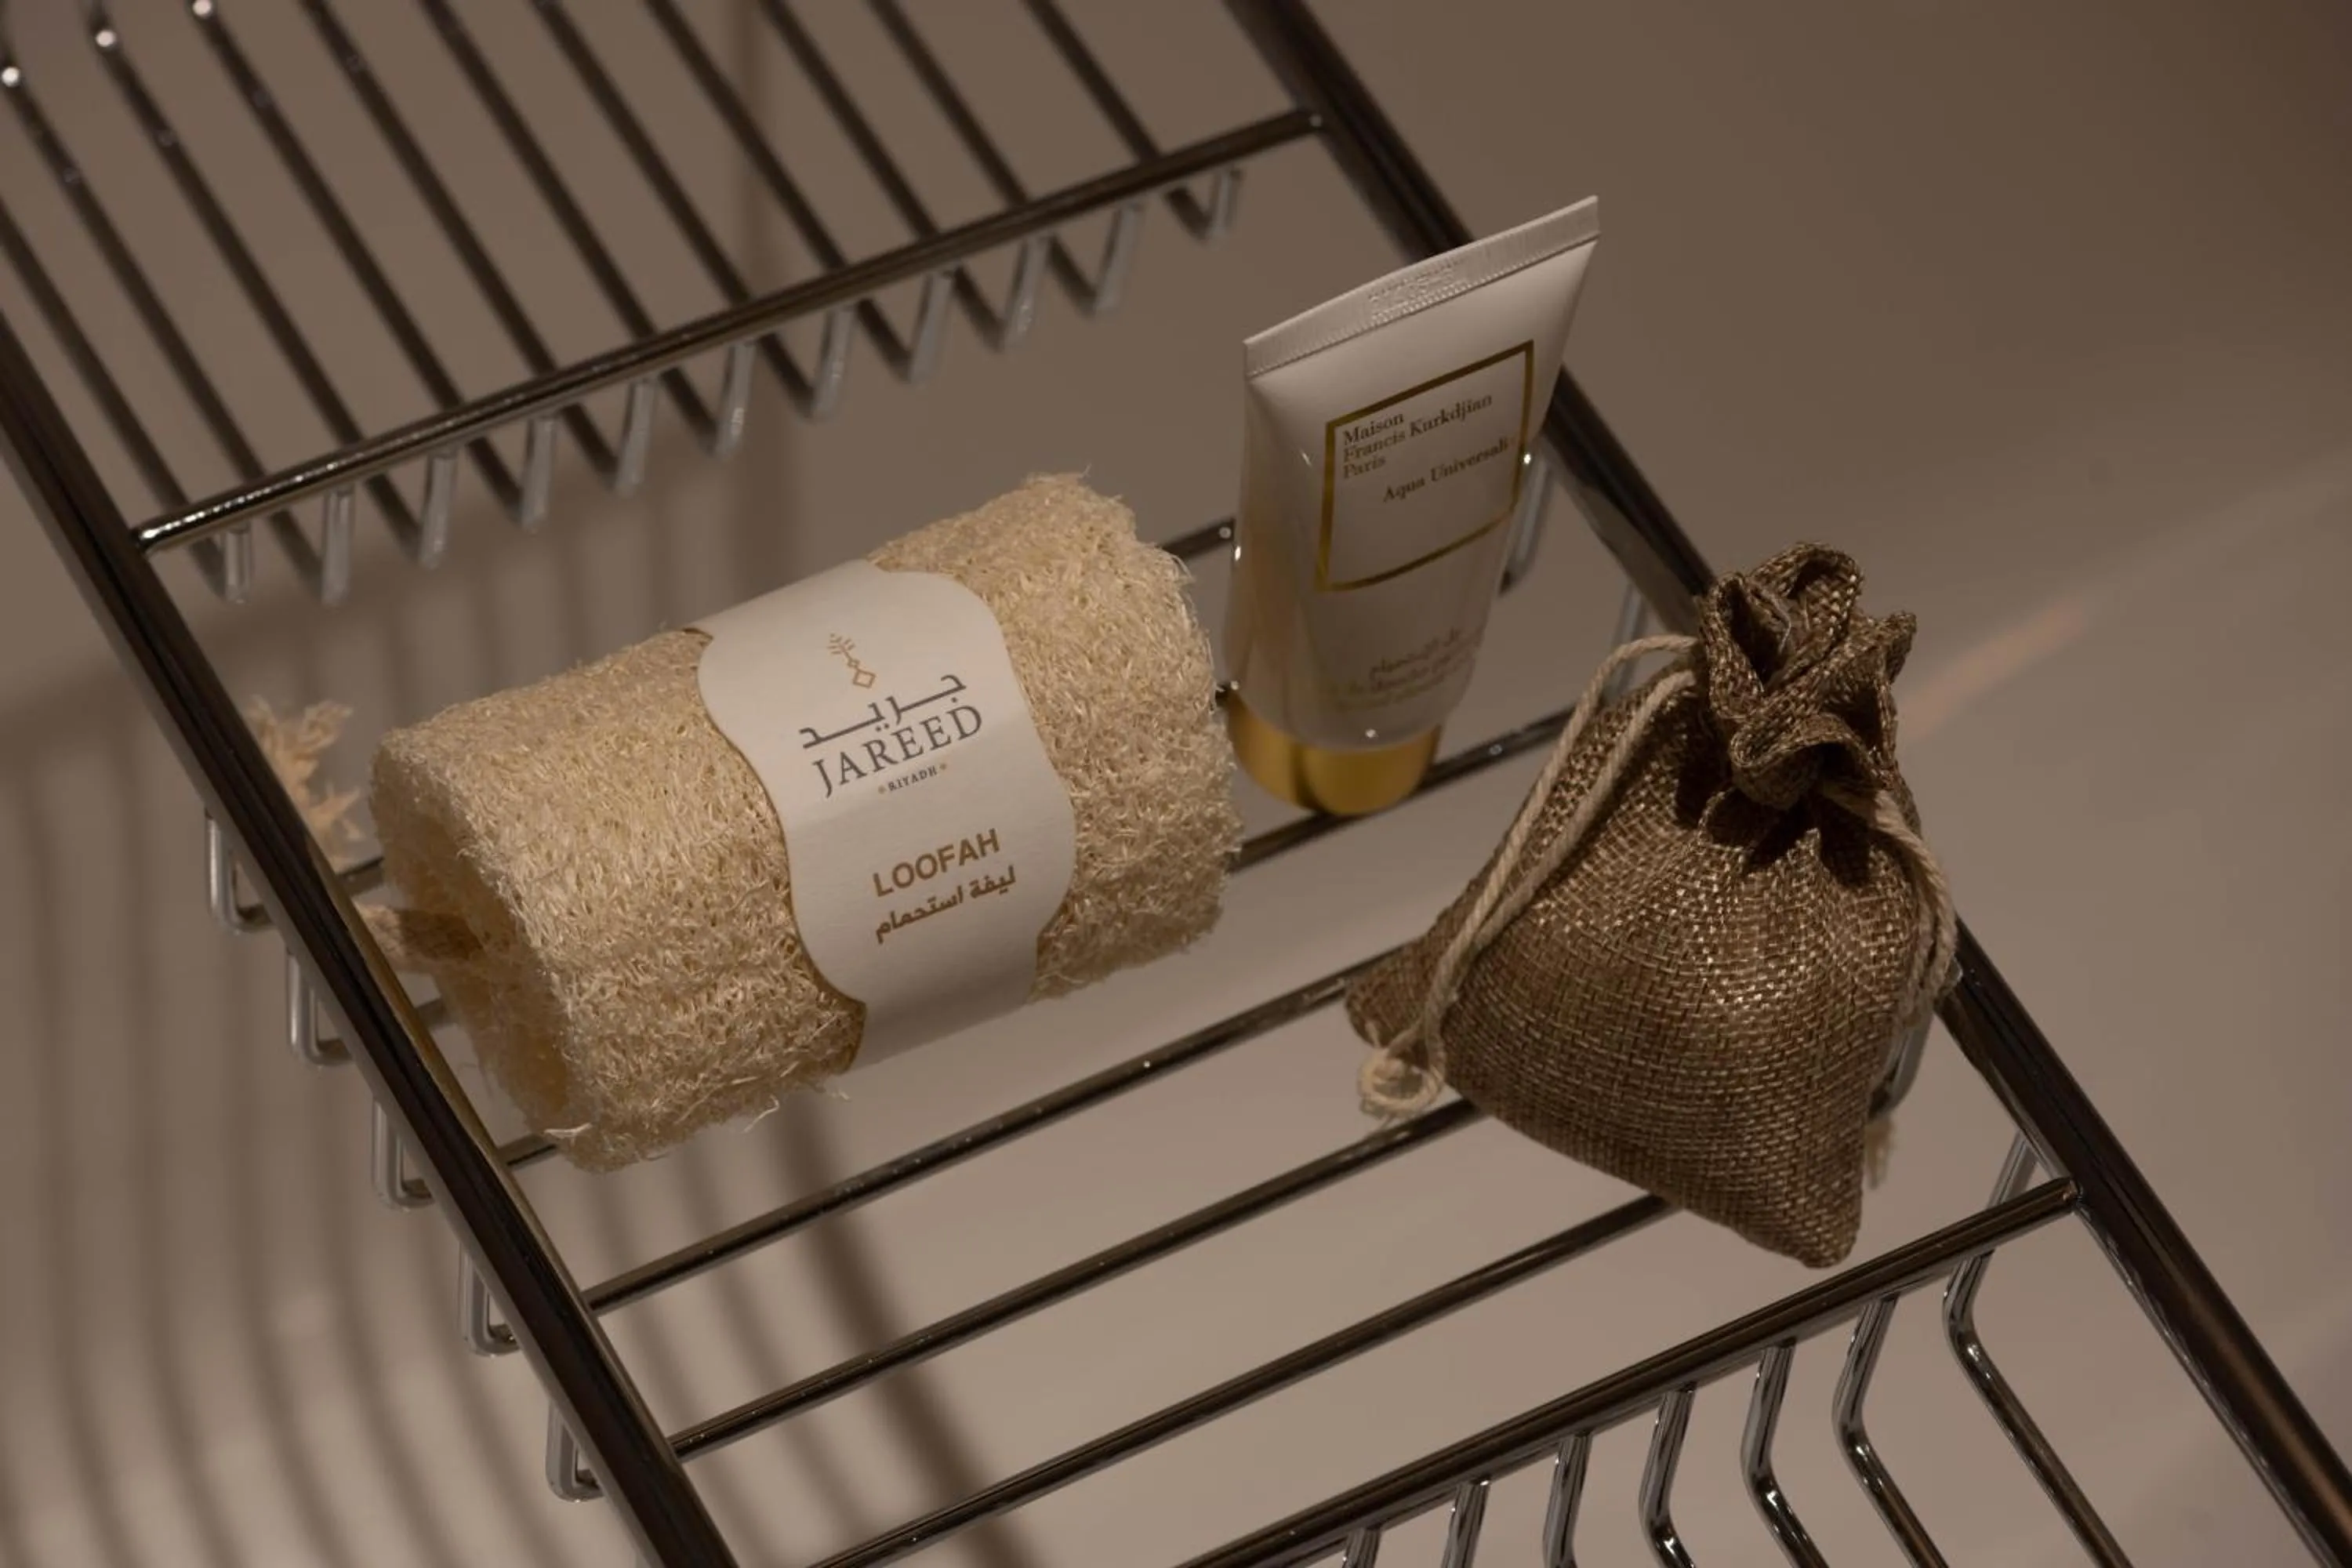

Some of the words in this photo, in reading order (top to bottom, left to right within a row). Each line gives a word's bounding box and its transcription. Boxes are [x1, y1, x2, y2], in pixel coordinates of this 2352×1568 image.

[1342, 412, 1404, 445] Maison
[1342, 429, 1406, 463] Francis
[1409, 394, 1493, 437] Kurkdjian
[1342, 454, 1387, 480] Paris
[1382, 476, 1426, 504] Aqua
[798, 673, 967, 750] جريد
[812, 703, 983, 798] JAREED
[887, 765, 938, 793] RIYADH
[873, 828, 1000, 898] LOOFAH
[970, 864, 1018, 900] ليفة
[875, 885, 965, 945] استحمام
